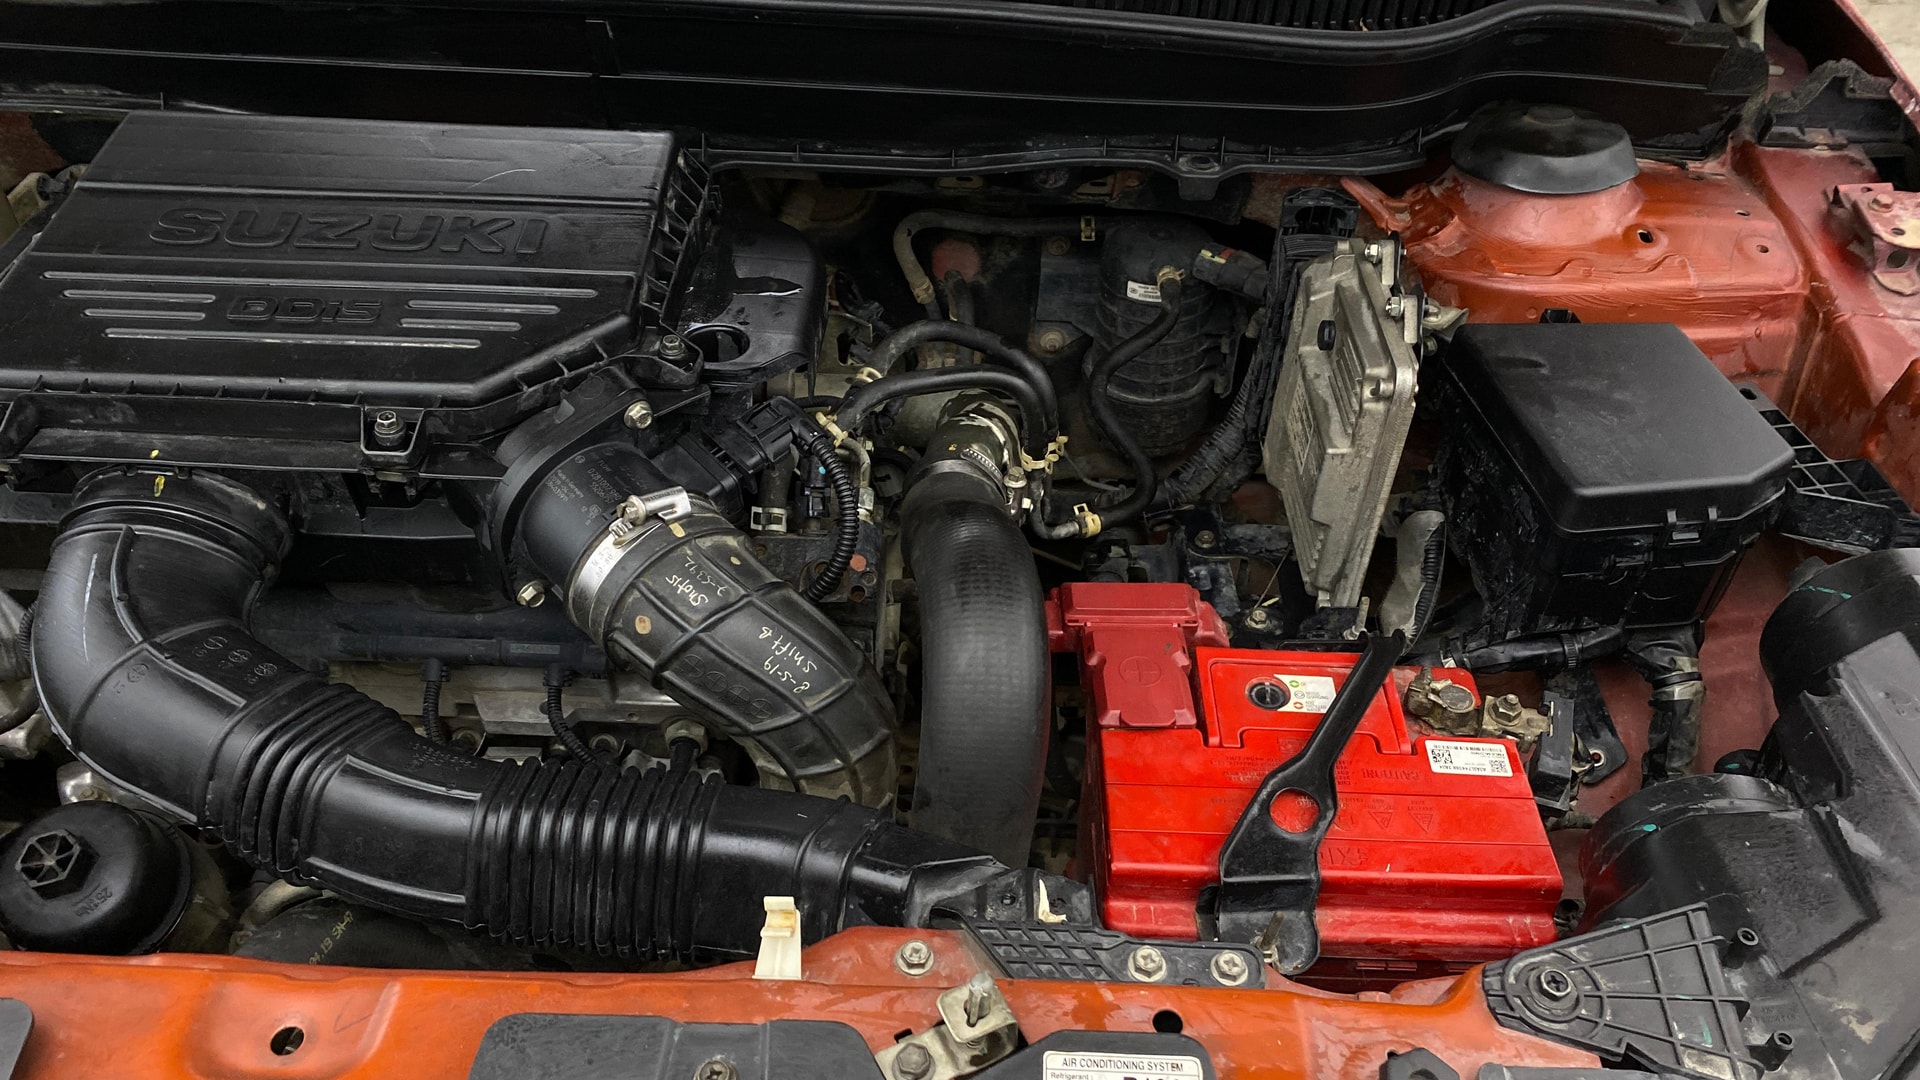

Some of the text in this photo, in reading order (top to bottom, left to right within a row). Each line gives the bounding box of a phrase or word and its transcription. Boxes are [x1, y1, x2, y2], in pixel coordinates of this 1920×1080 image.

[149, 207, 549, 254] SUZUKI
[226, 297, 384, 323] DDiS
[1062, 1057, 1184, 1072] AIR CONDITIONING SYSTEM
